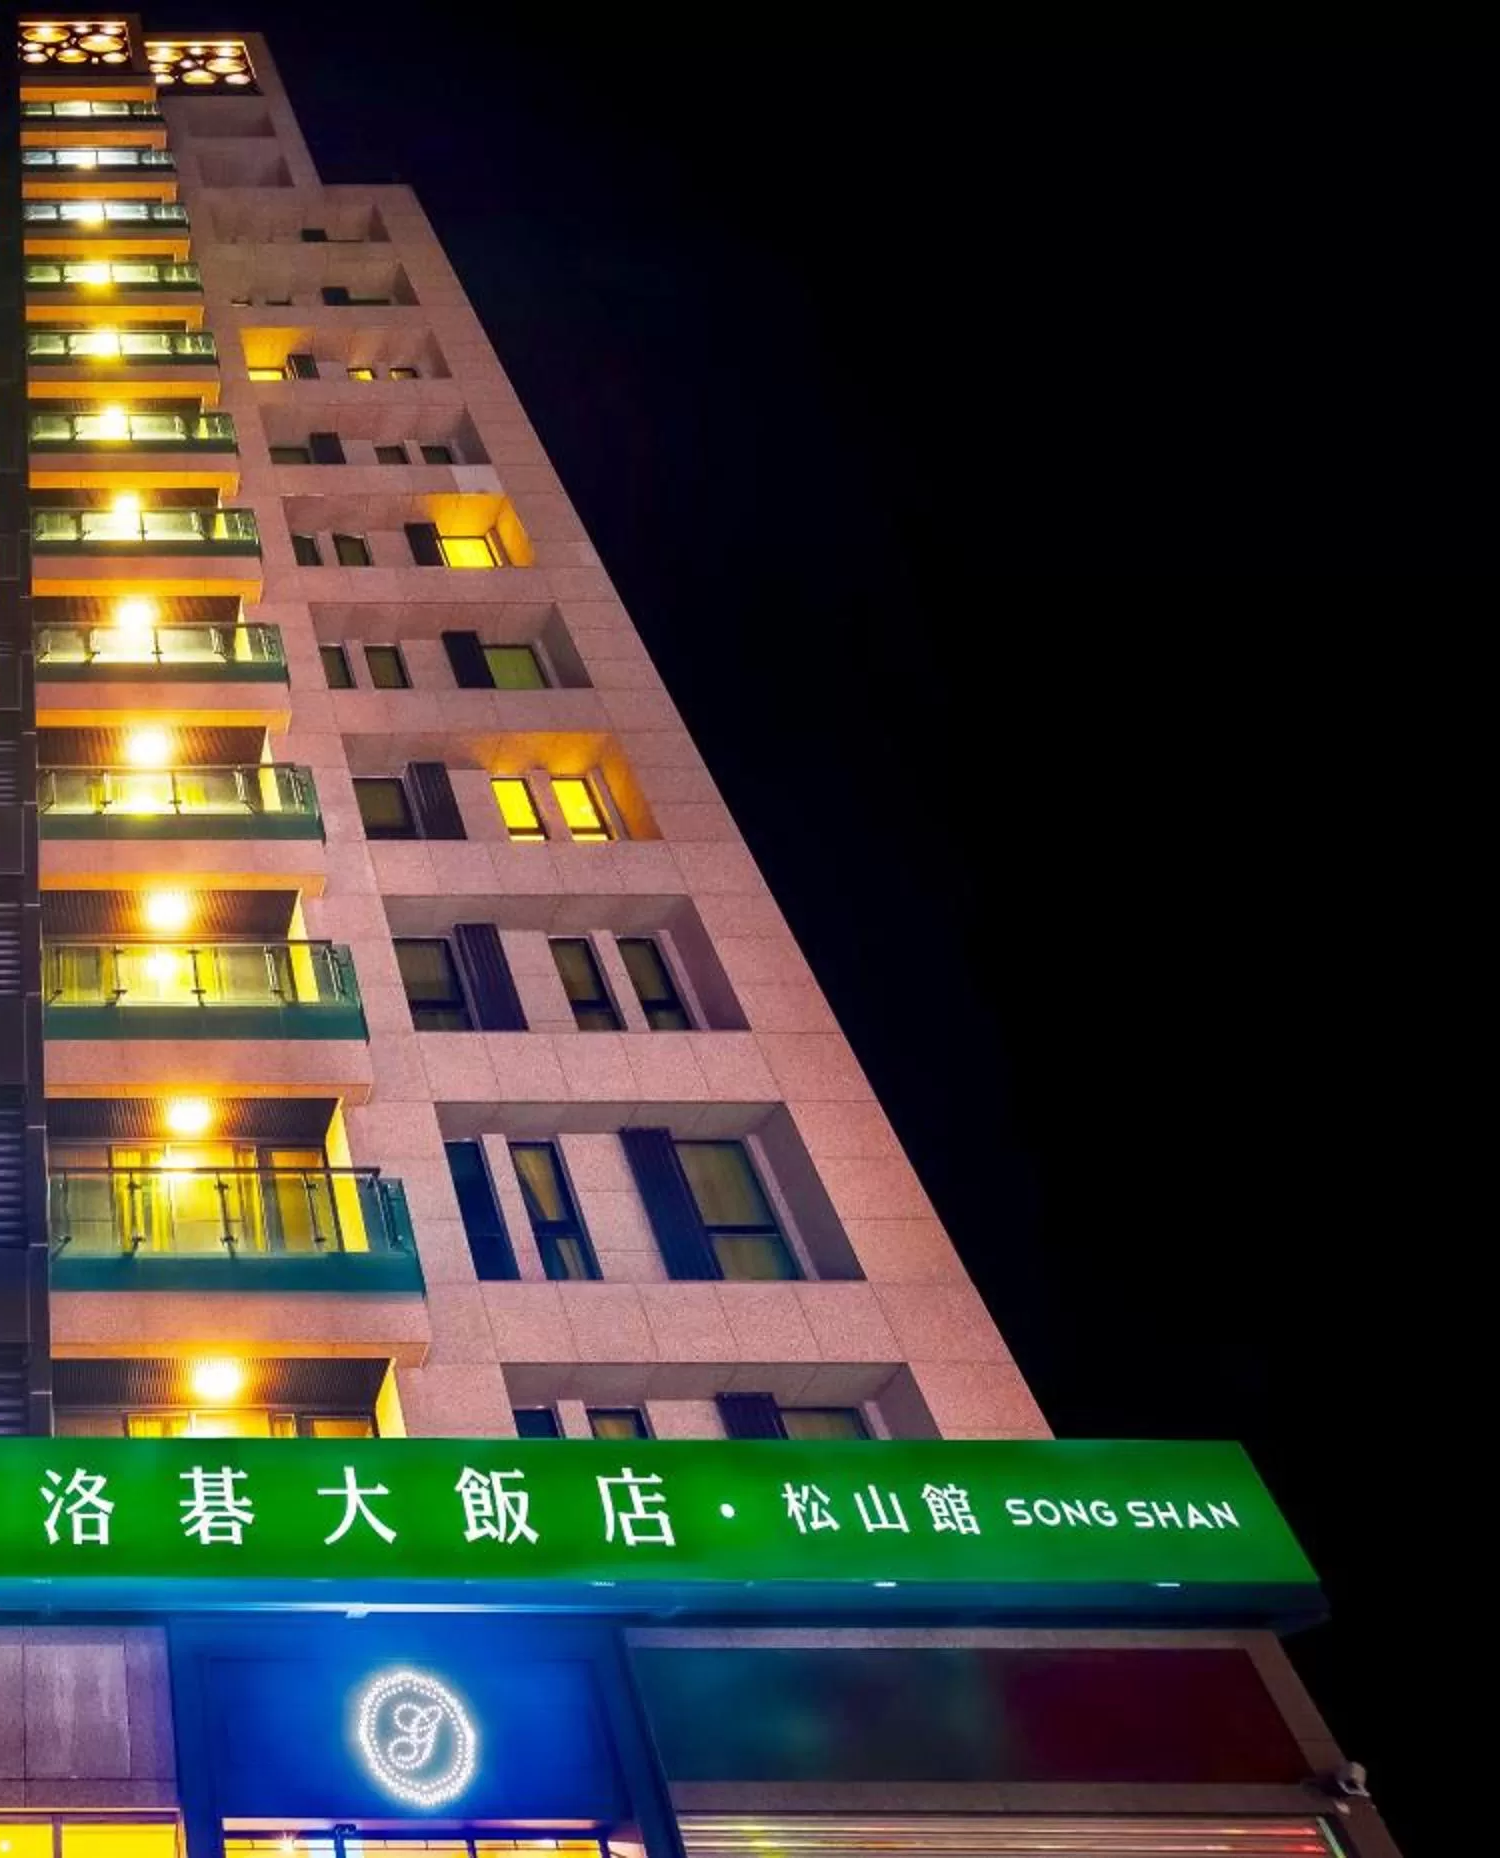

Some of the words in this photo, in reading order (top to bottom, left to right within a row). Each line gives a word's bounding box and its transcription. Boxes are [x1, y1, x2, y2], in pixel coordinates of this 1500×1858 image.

[39, 1465, 676, 1547] 洛碁大飯店
[781, 1481, 982, 1535] 松山館
[1004, 1498, 1119, 1528] SONG
[1126, 1500, 1240, 1530] SHAN
